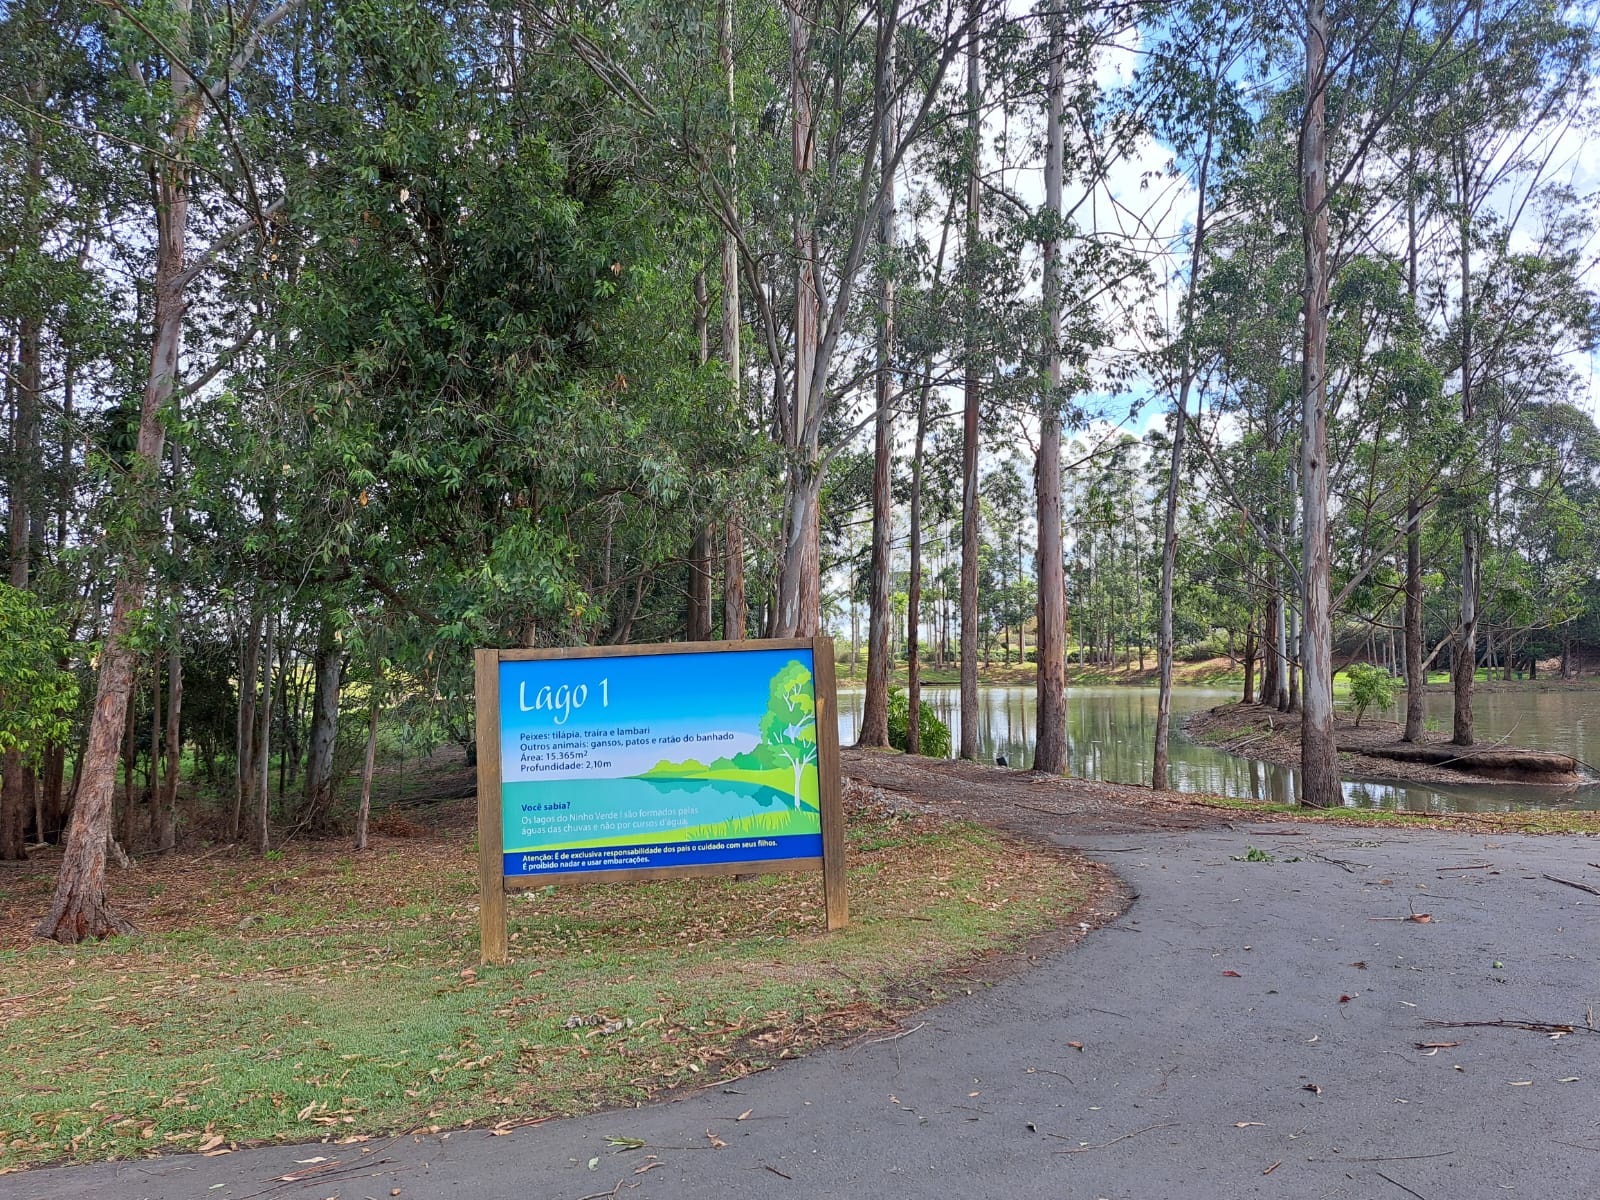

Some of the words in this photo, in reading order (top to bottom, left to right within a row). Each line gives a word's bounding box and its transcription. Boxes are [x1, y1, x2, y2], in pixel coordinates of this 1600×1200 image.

[519, 680, 588, 725] Lago
[599, 678, 609, 708] 1
[520, 732, 550, 741] Peixes:
[552, 730, 582, 740] tilápia,
[617, 725, 650, 736] lambari
[520, 743, 550, 752] Outros
[552, 740, 588, 750] animais:
[590, 739, 624, 749] gansos,
[625, 737, 649, 748] patos
[658, 735, 681, 744] ratão
[683, 733, 694, 743] do
[696, 731, 734, 742] banhado
[520, 752, 544, 762] Área:
[520, 761, 584, 773] Profundidade:
[586, 760, 612, 770] 2,10m
[521, 802, 541, 812] Você
[543, 801, 571, 811] sabia?
[521, 816, 532, 825] Os
[533, 815, 555, 826] lagos
[556, 814, 568, 822] do
[569, 812, 594, 821] Ninho
[595, 811, 618, 820] Verde
[624, 809, 638, 818] são
[639, 807, 677, 817] formados
[678, 806, 699, 816] pelas
[521, 827, 546, 837] águas
[547, 825, 561, 833] das
[563, 823, 592, 832] chuvas
[600, 821, 615, 830] não
[617, 822, 631, 831] por
[632, 819, 658, 828] cursos
[522, 854, 554, 863] Atenção:
[554, 851, 559, 860] É
[560, 852, 570, 860] de
[571, 850, 602, 859] exclusiva
[603, 846, 662, 857] responsabilidade
[663, 845, 676, 853] dos
[676, 844, 691, 853] pais
[697, 842, 725, 851] cuidado
[757, 839, 778, 847] filhos.
[522, 862, 528, 871] É
[528, 860, 559, 871] proibido
[560, 859, 580, 868] nadar
[603, 856, 650, 865] embarcações.
